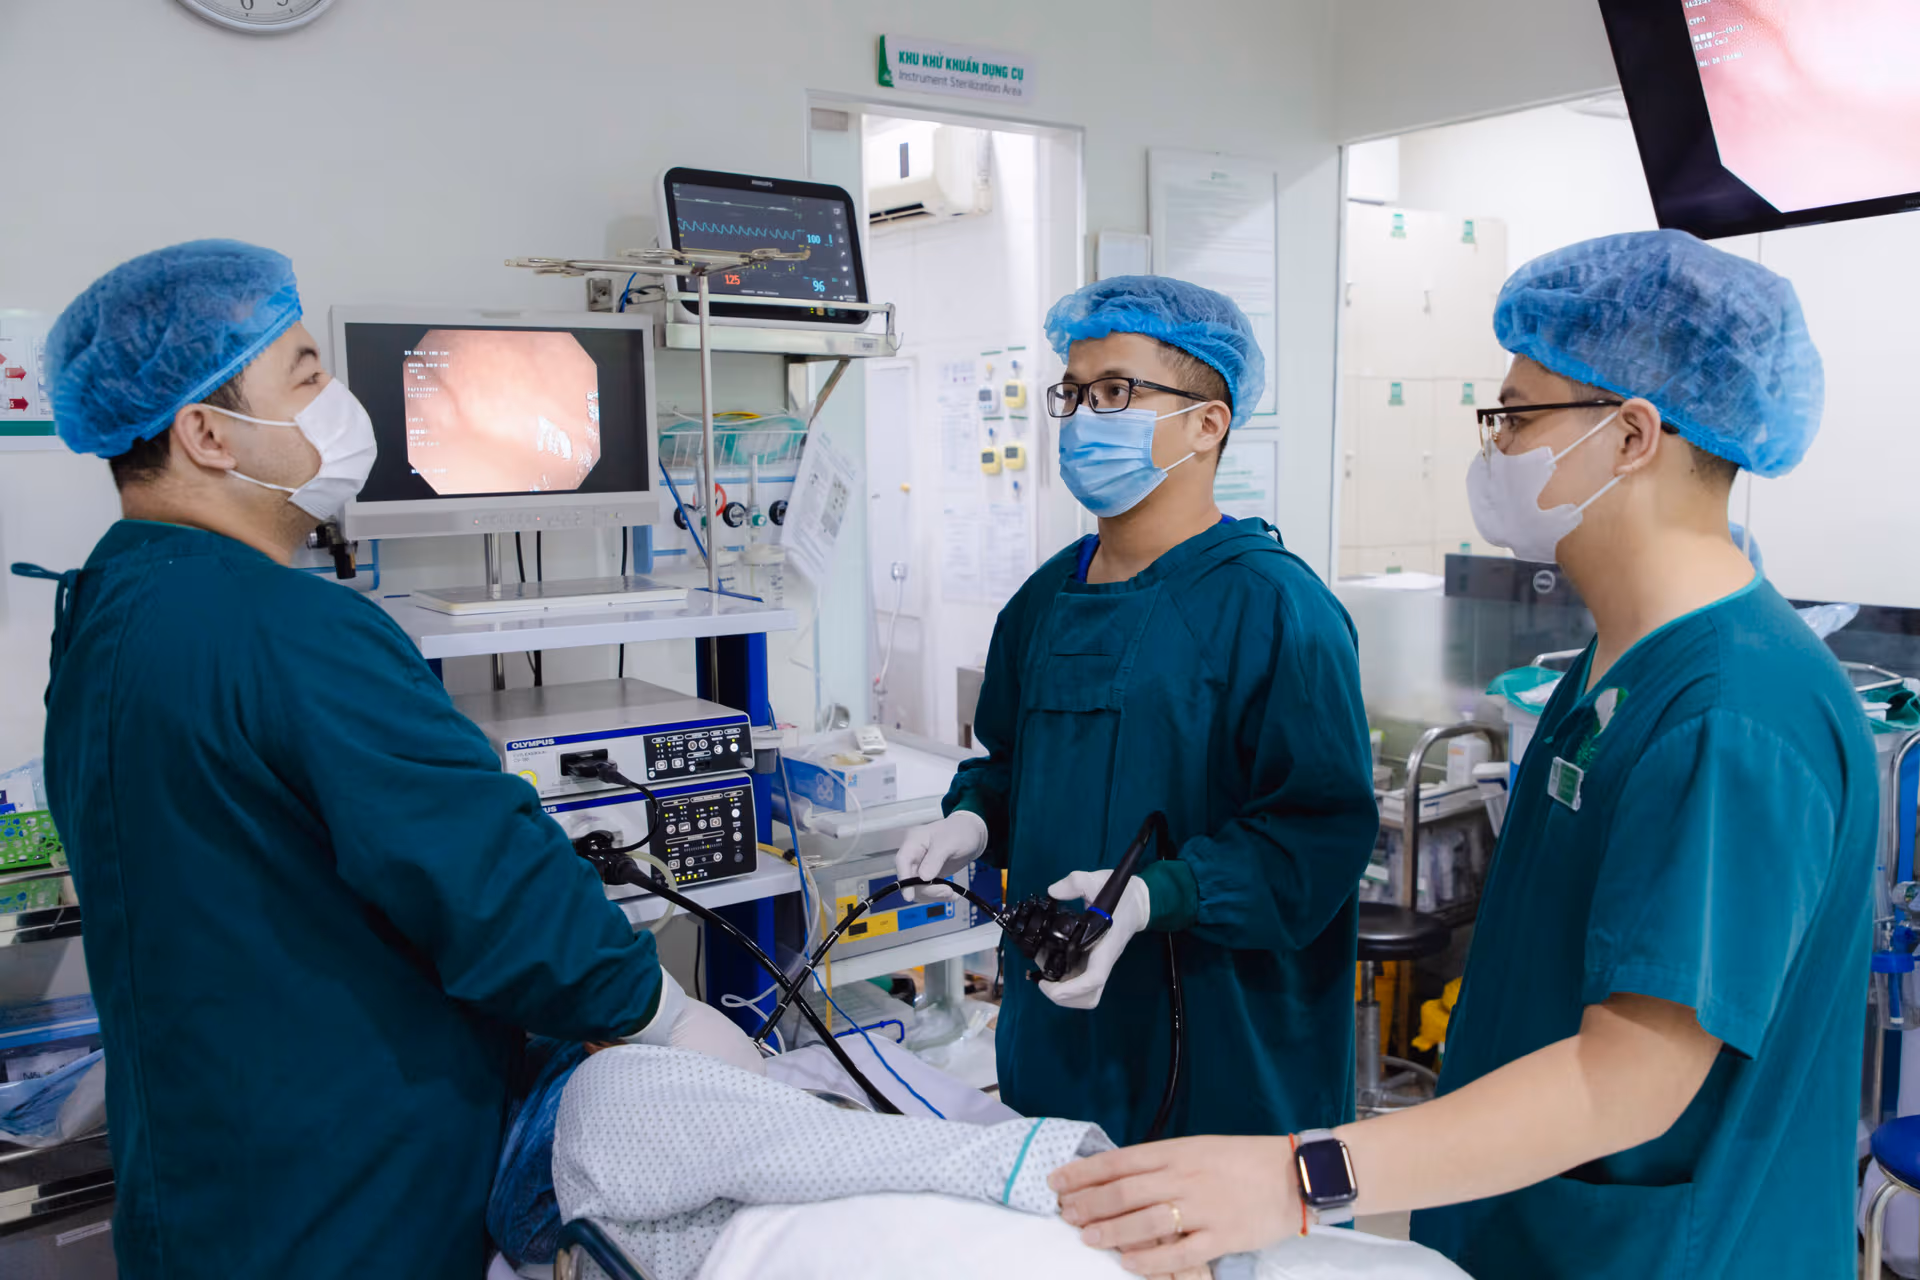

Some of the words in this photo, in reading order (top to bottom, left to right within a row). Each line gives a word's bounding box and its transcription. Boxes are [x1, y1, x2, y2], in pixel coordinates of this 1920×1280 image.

[898, 51, 919, 65] KHU
[922, 52, 943, 69] KHỬ
[982, 63, 1008, 79] DỤNG
[1011, 67, 1024, 83] CỤ
[898, 70, 947, 87] Instrument
[950, 76, 1000, 94] Sterilization
[1002, 84, 1022, 96] Area
[807, 234, 821, 245] 100
[725, 274, 740, 285] 125
[812, 280, 826, 292] 96
[511, 738, 555, 749] OLYMPUS
